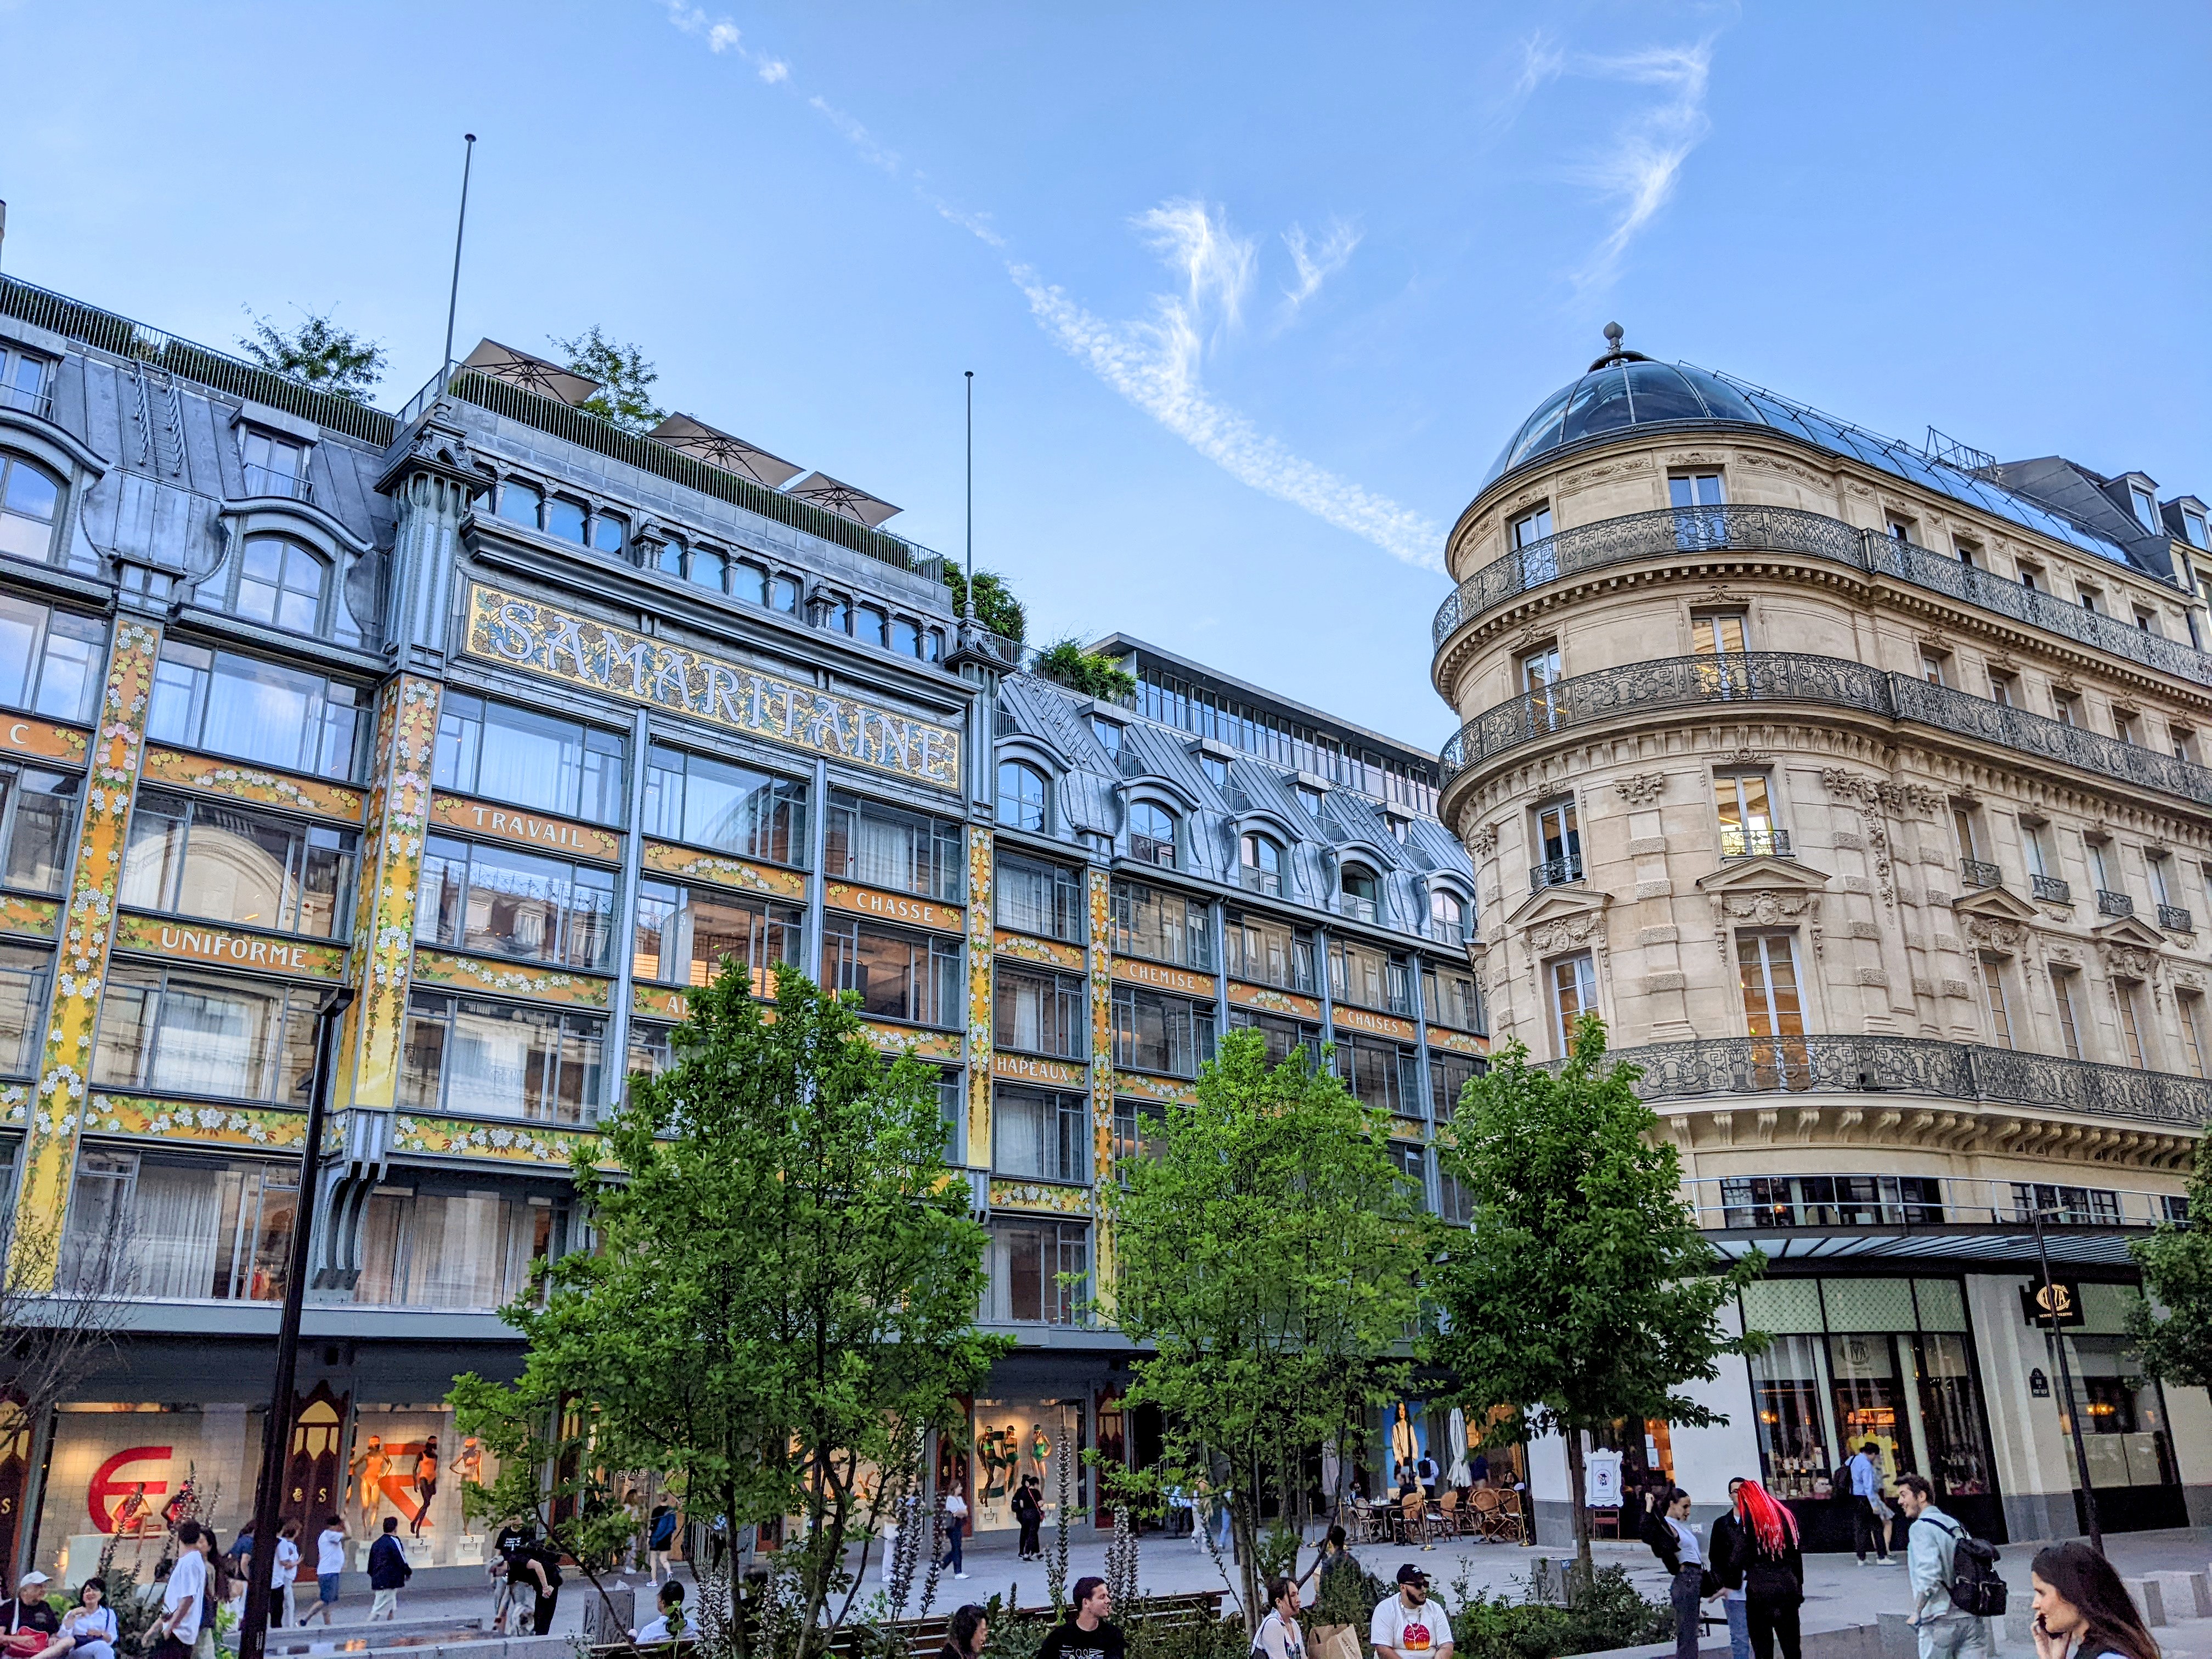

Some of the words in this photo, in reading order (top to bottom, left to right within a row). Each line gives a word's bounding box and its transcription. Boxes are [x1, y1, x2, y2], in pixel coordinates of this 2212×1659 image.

[494, 602, 946, 781] SAMARITAINE
[471, 805, 584, 848] TRAVAIL
[856, 892, 934, 922] CHASSE
[161, 927, 307, 969] UNIFORME
[1130, 964, 1195, 989] CHEMISE
[1348, 1011, 1398, 1033] CHAISES
[993, 1056, 1069, 1081] HAPEAUX
